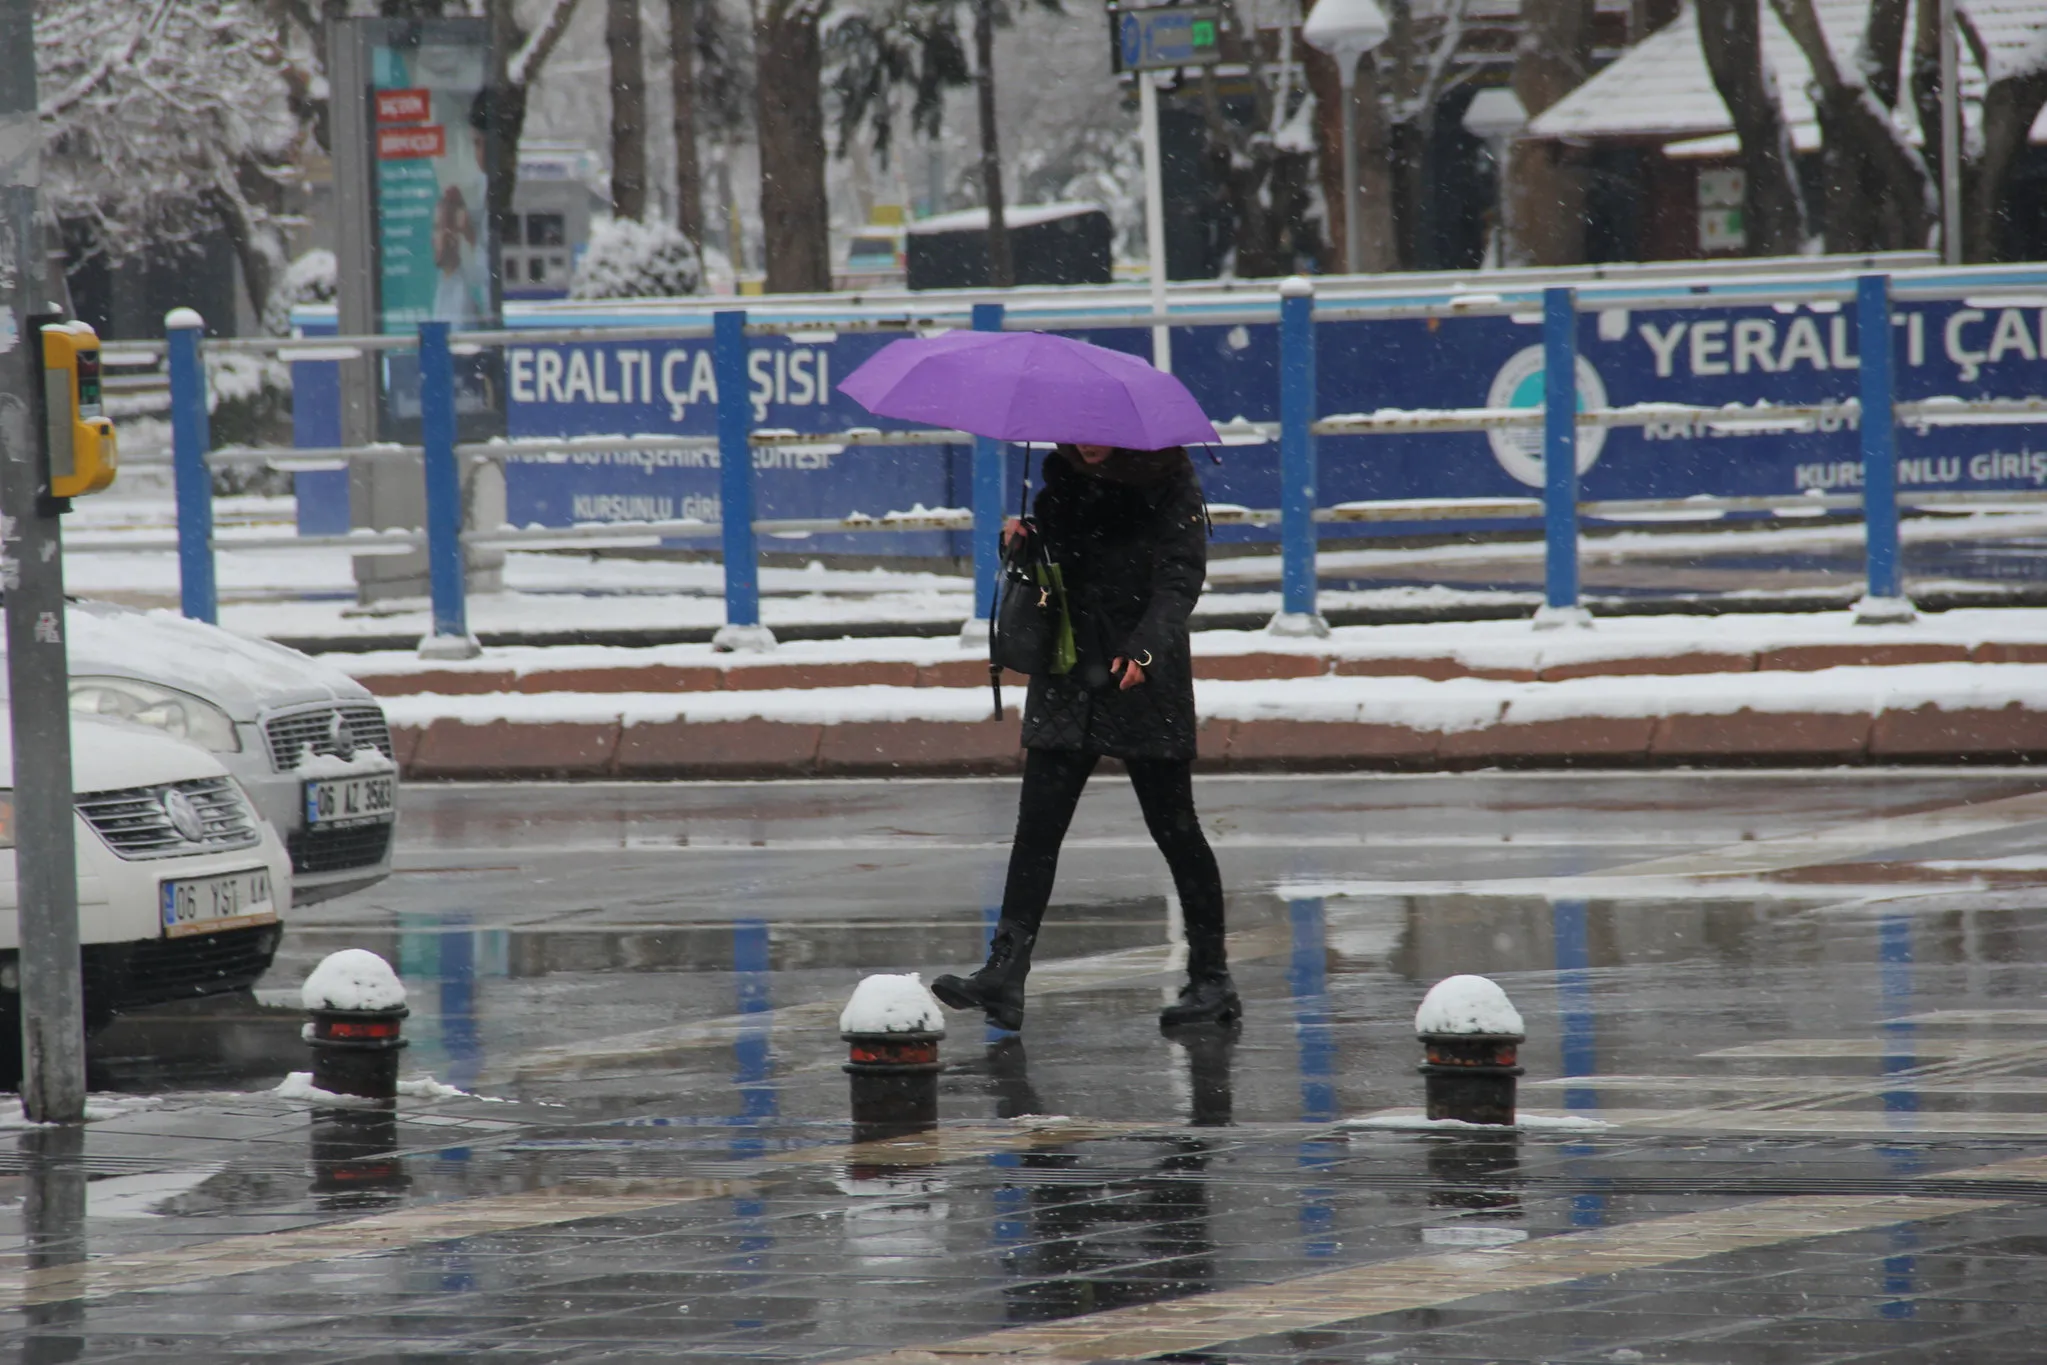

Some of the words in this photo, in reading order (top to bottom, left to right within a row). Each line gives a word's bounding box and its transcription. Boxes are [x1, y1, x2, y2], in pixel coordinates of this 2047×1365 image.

[660, 349, 829, 422] ÇAŞISI
[318, 785, 335, 816] 06
[176, 885, 196, 920] 06
[211, 880, 238, 917] YST
